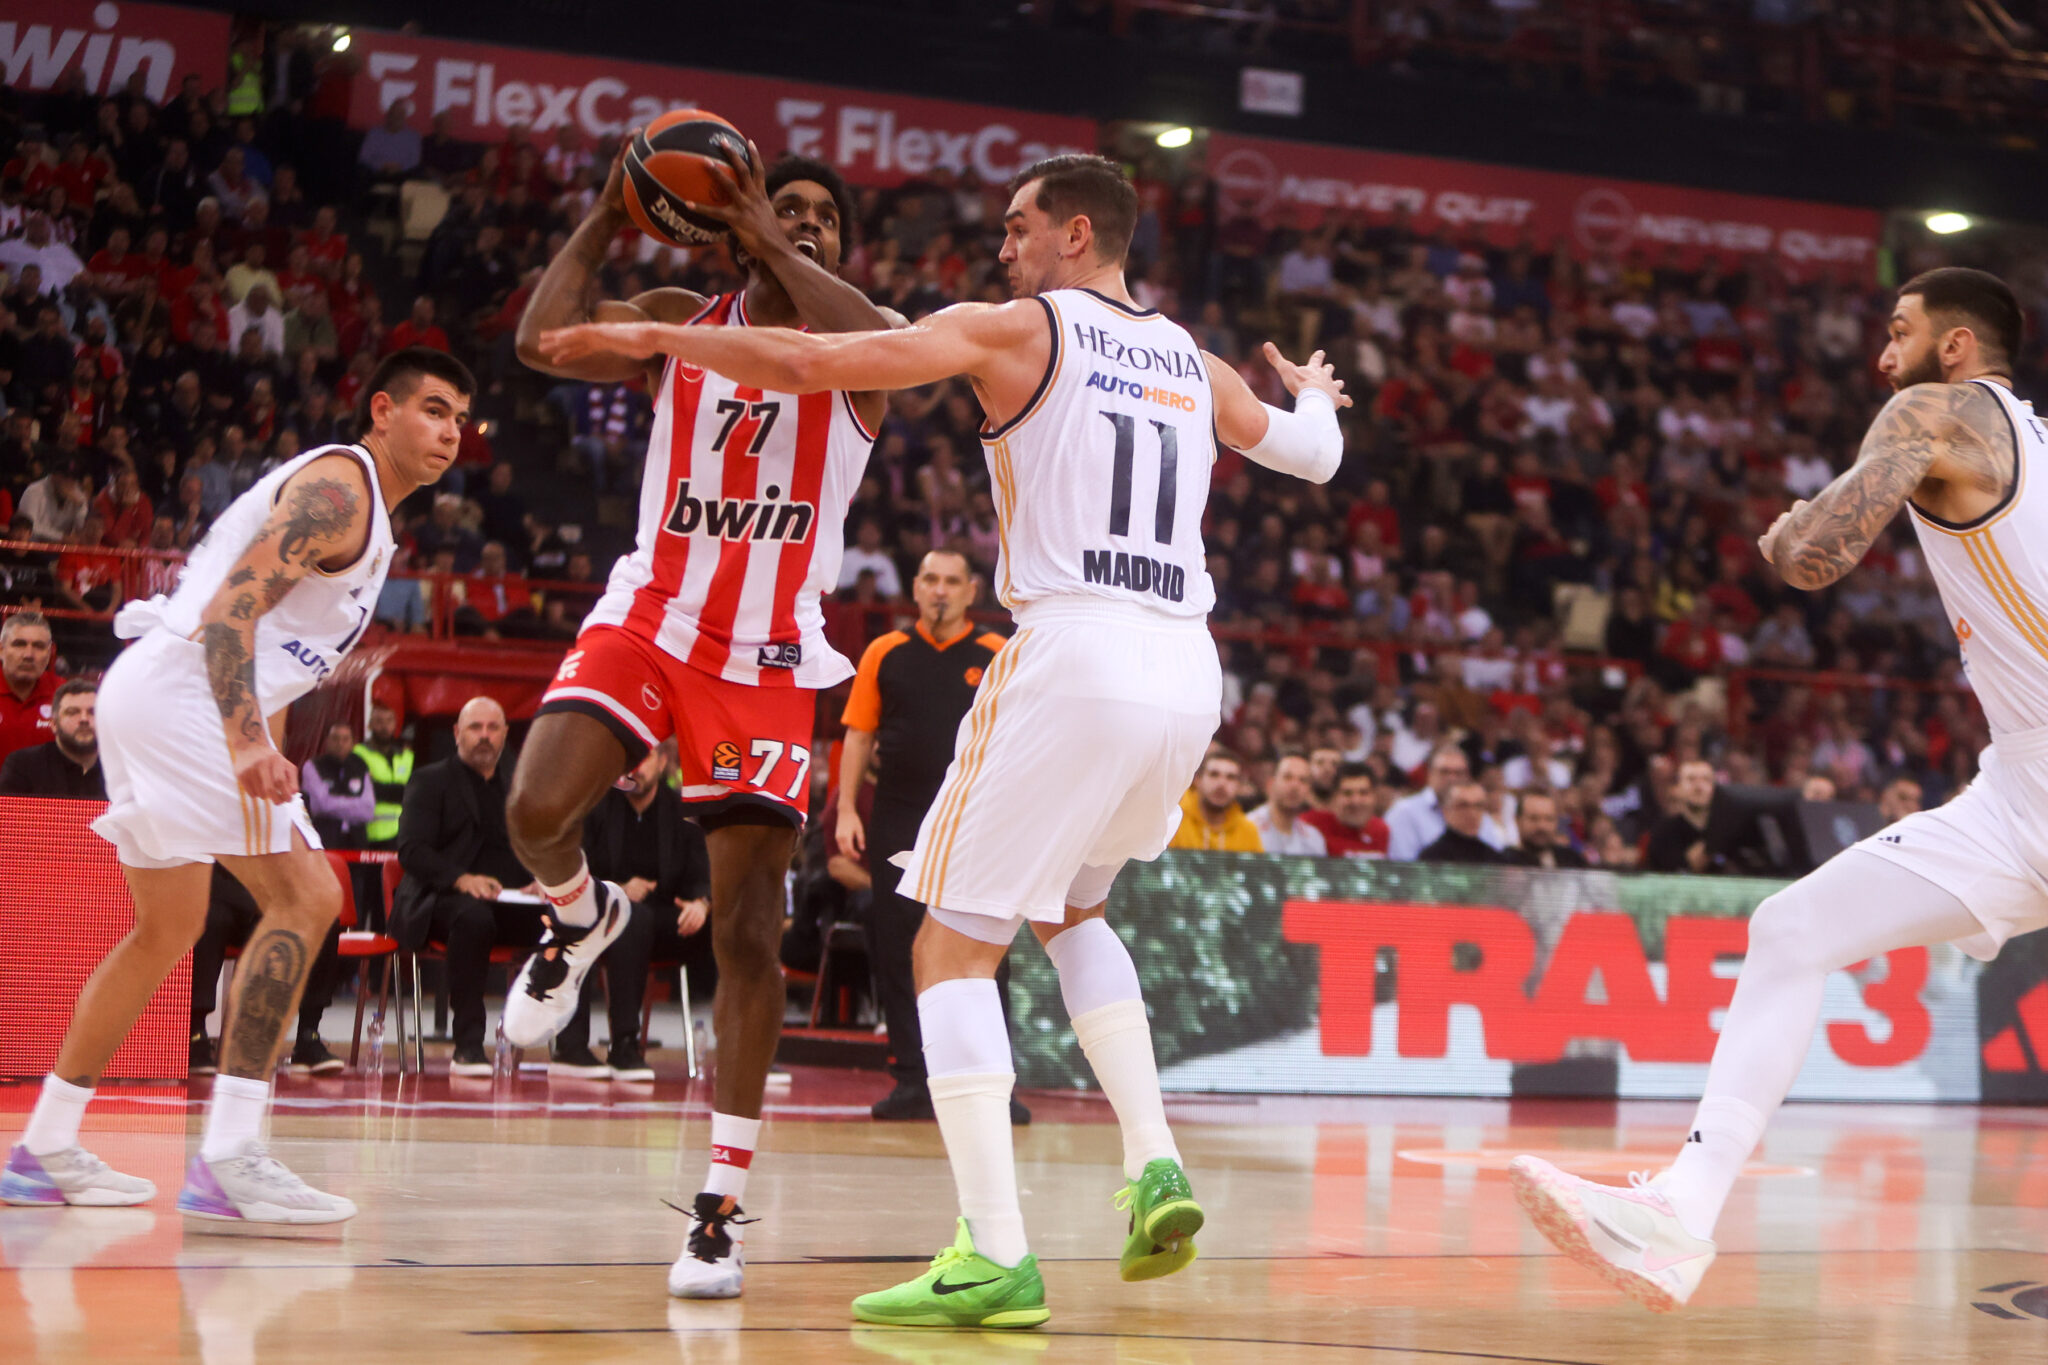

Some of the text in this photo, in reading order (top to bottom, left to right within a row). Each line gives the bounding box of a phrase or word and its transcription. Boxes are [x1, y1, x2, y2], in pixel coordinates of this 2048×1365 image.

[432, 57, 697, 136] FlexCa
[836, 106, 1080, 184] FlexCa
[1073, 322, 1203, 383] HEZONJA
[1086, 370, 1196, 413] AUTOHERO
[711, 398, 781, 457] 77
[1098, 410, 1178, 546] 11
[663, 478, 815, 544] bwin
[1083, 549, 1185, 603] MADRID
[748, 738, 811, 800] 77
[1281, 895, 1749, 1065] TRAE
